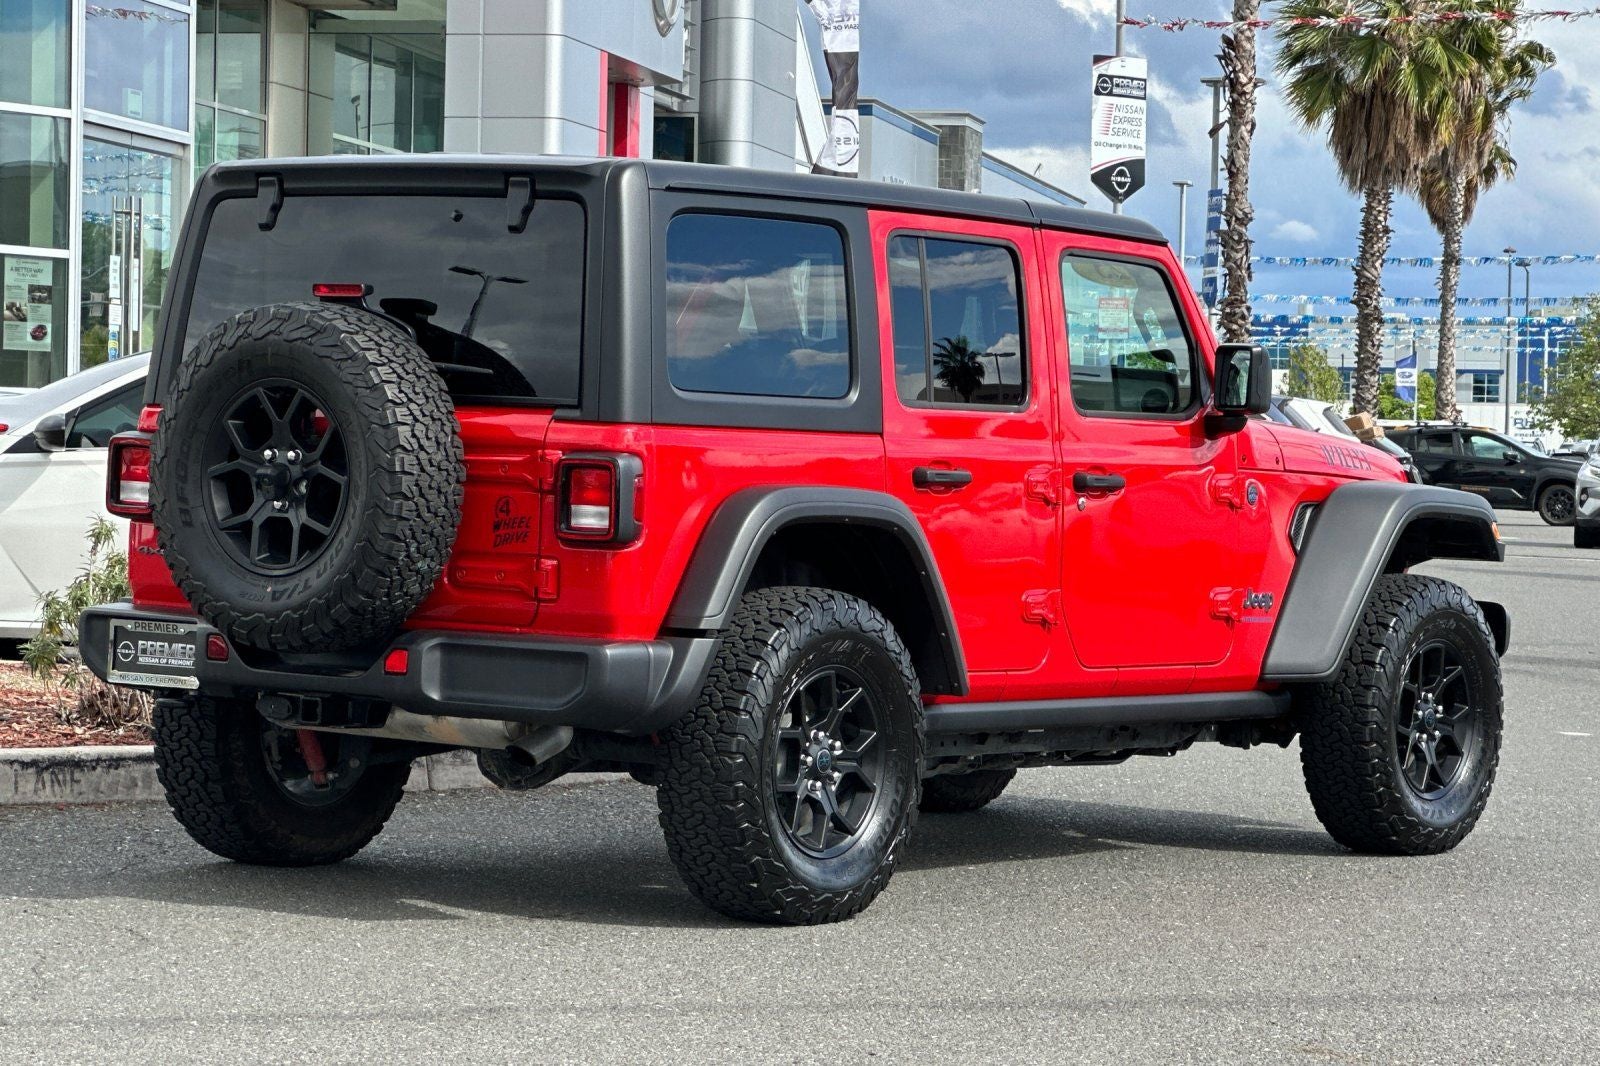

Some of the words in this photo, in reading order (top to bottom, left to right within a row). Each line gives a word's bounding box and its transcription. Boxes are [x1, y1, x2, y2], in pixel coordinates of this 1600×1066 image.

[1114, 103, 1145, 116] NISSAN
[1112, 115, 1143, 128] EXPRESS
[1110, 127, 1142, 139] SERVICE
[1102, 141, 1122, 150] Change
[1320, 444, 1372, 471] WILLYS
[499, 498, 511, 517] 4
[493, 515, 532, 532] WHEEL
[493, 531, 531, 548] DRIVE
[1243, 588, 1274, 613] Jeep
[134, 621, 179, 633] PREMIER
[137, 640, 196, 658] PREMIER
[138, 656, 160, 664] NISSAN
[119, 674, 144, 682] NISSAN
[155, 677, 187, 685] FREMONT
